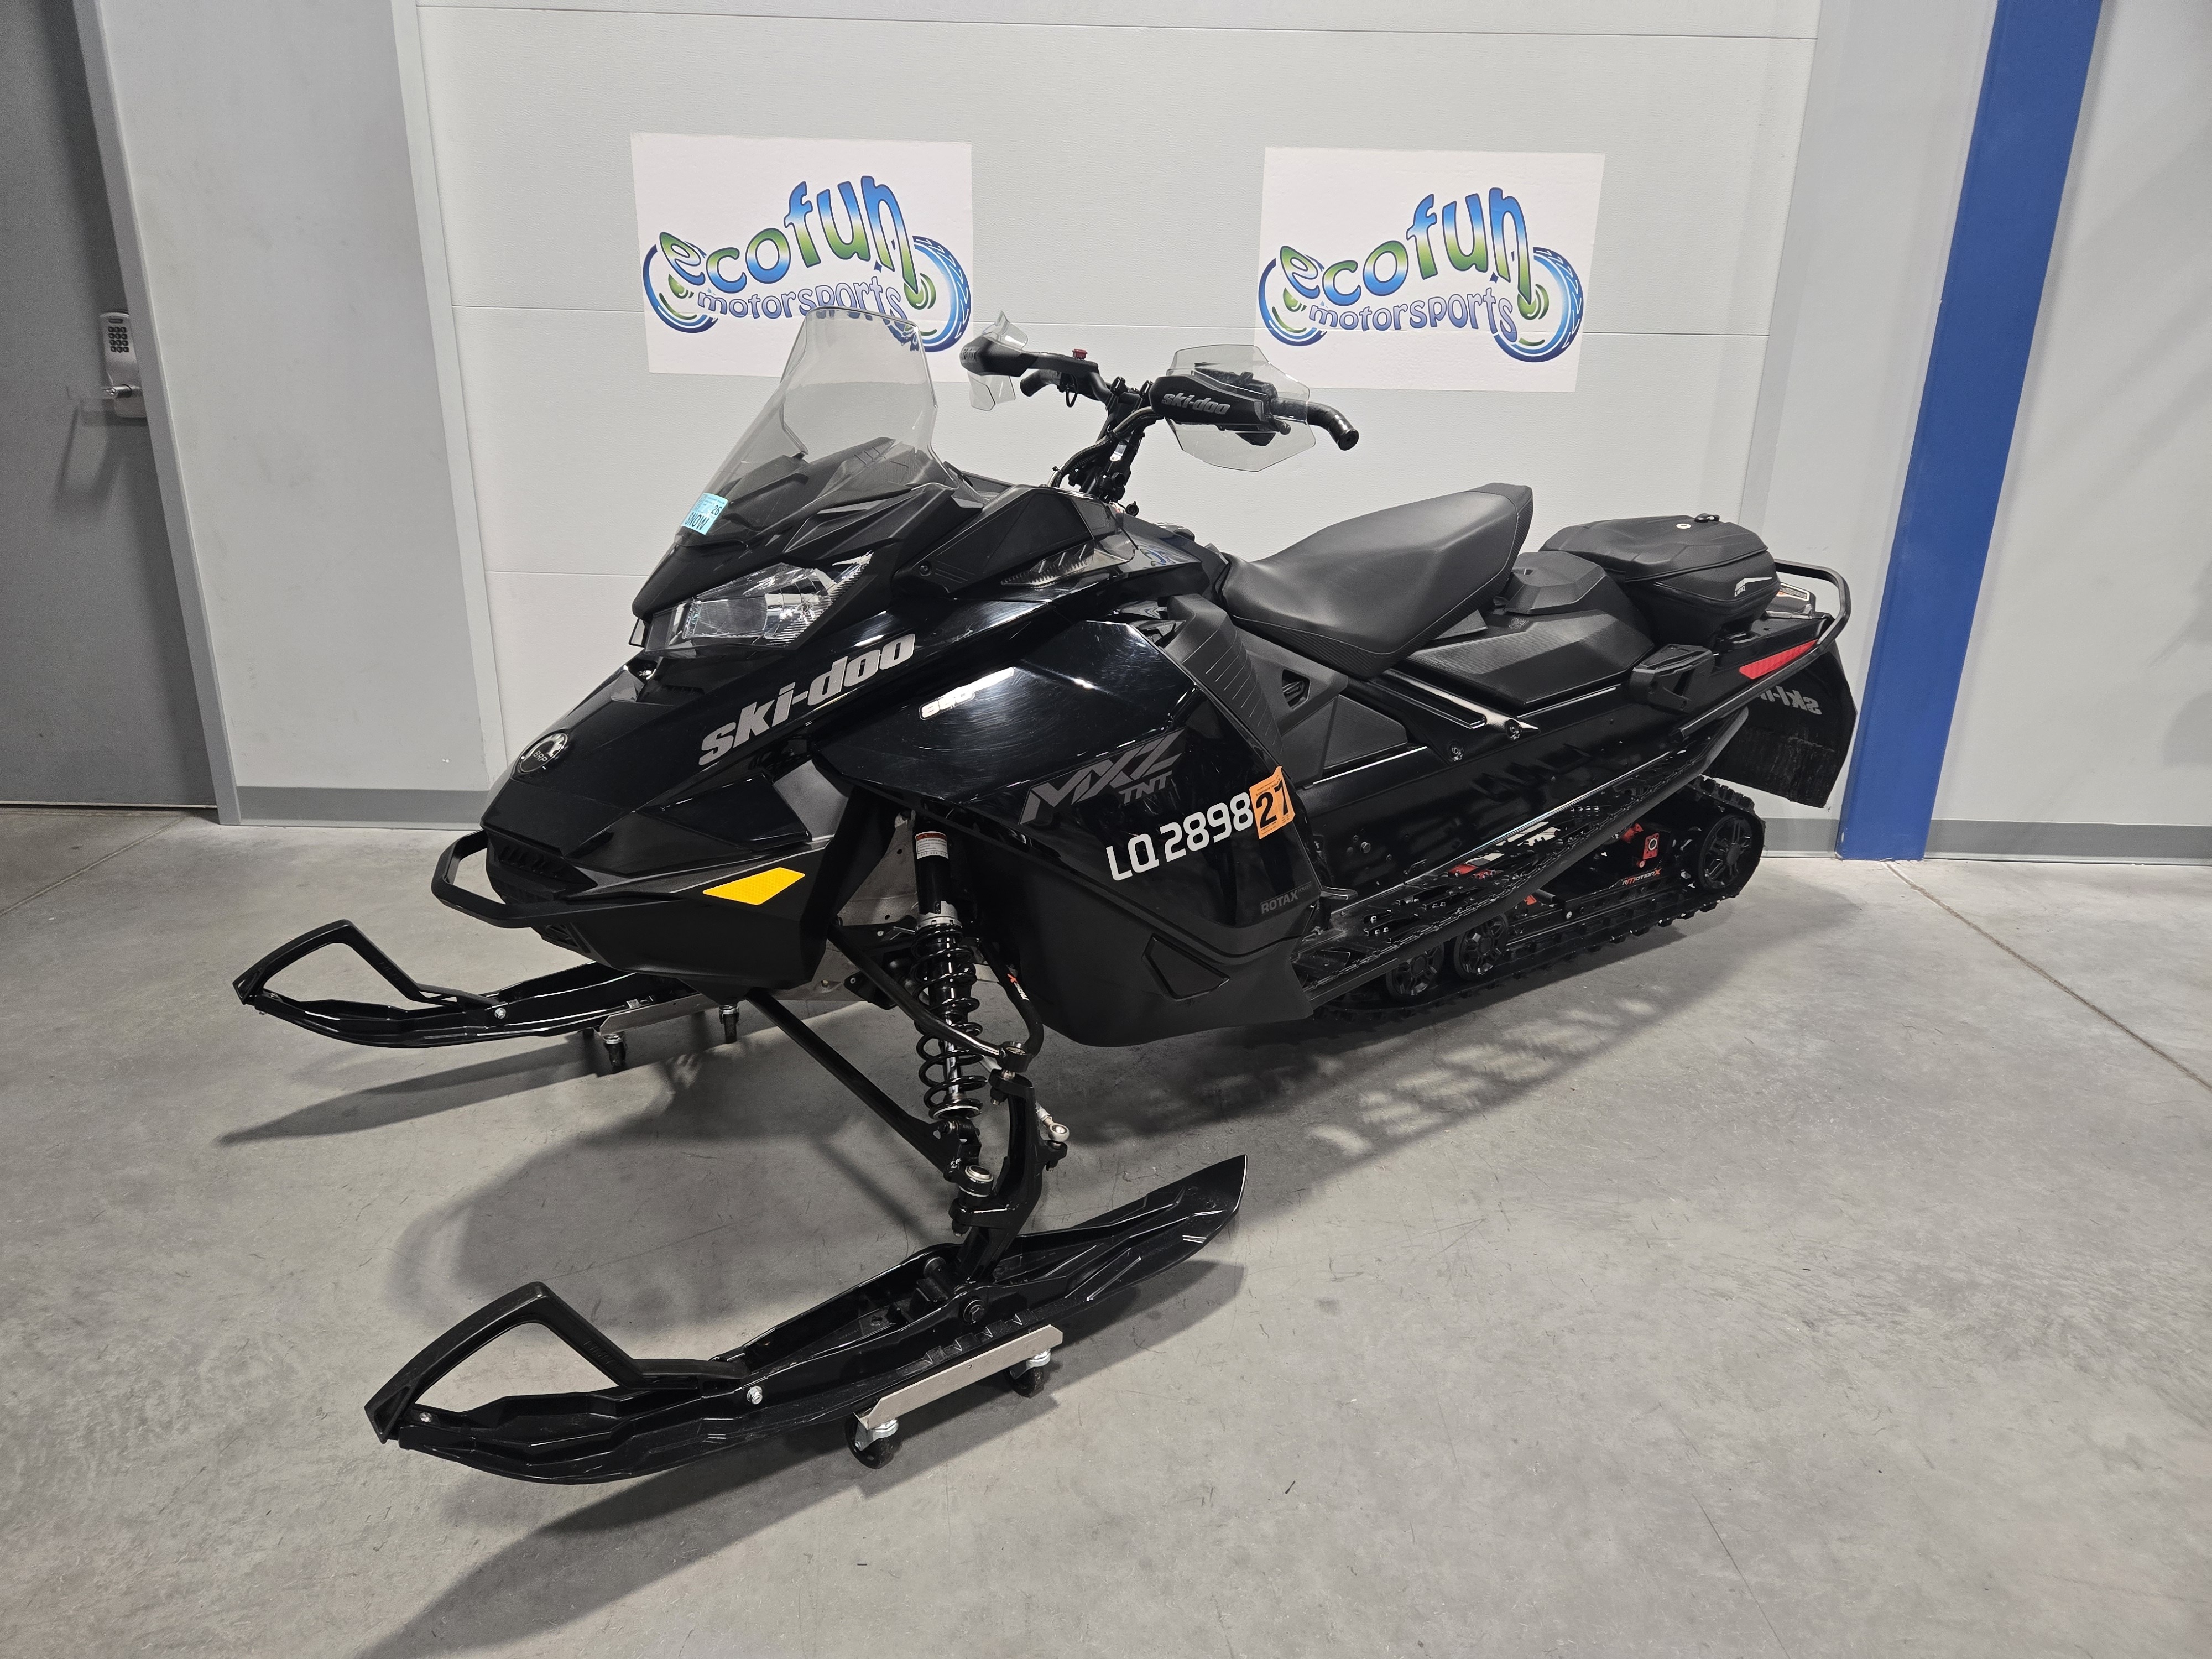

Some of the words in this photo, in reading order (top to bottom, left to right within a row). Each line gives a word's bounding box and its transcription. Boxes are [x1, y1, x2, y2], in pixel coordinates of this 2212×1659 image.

[659, 175, 919, 294] ecofun
[1279, 187, 1532, 306] ecofun
[697, 276, 910, 332] motorsports
[1308, 286, 1517, 343] motorsports
[1161, 392, 1231, 415] ski-doo
[684, 512, 710, 531] SNOW
[711, 504, 722, 516] 26
[698, 633, 916, 766] ski-doo
[533, 750, 549, 762] BRP
[1018, 728, 1187, 825] MXZ
[1118, 770, 1173, 806] TNT
[1256, 779, 1289, 829] 27
[1106, 833, 1160, 881] LQ
[1160, 791, 1254, 863] 2898
[1261, 889, 1299, 915] ROTAX
